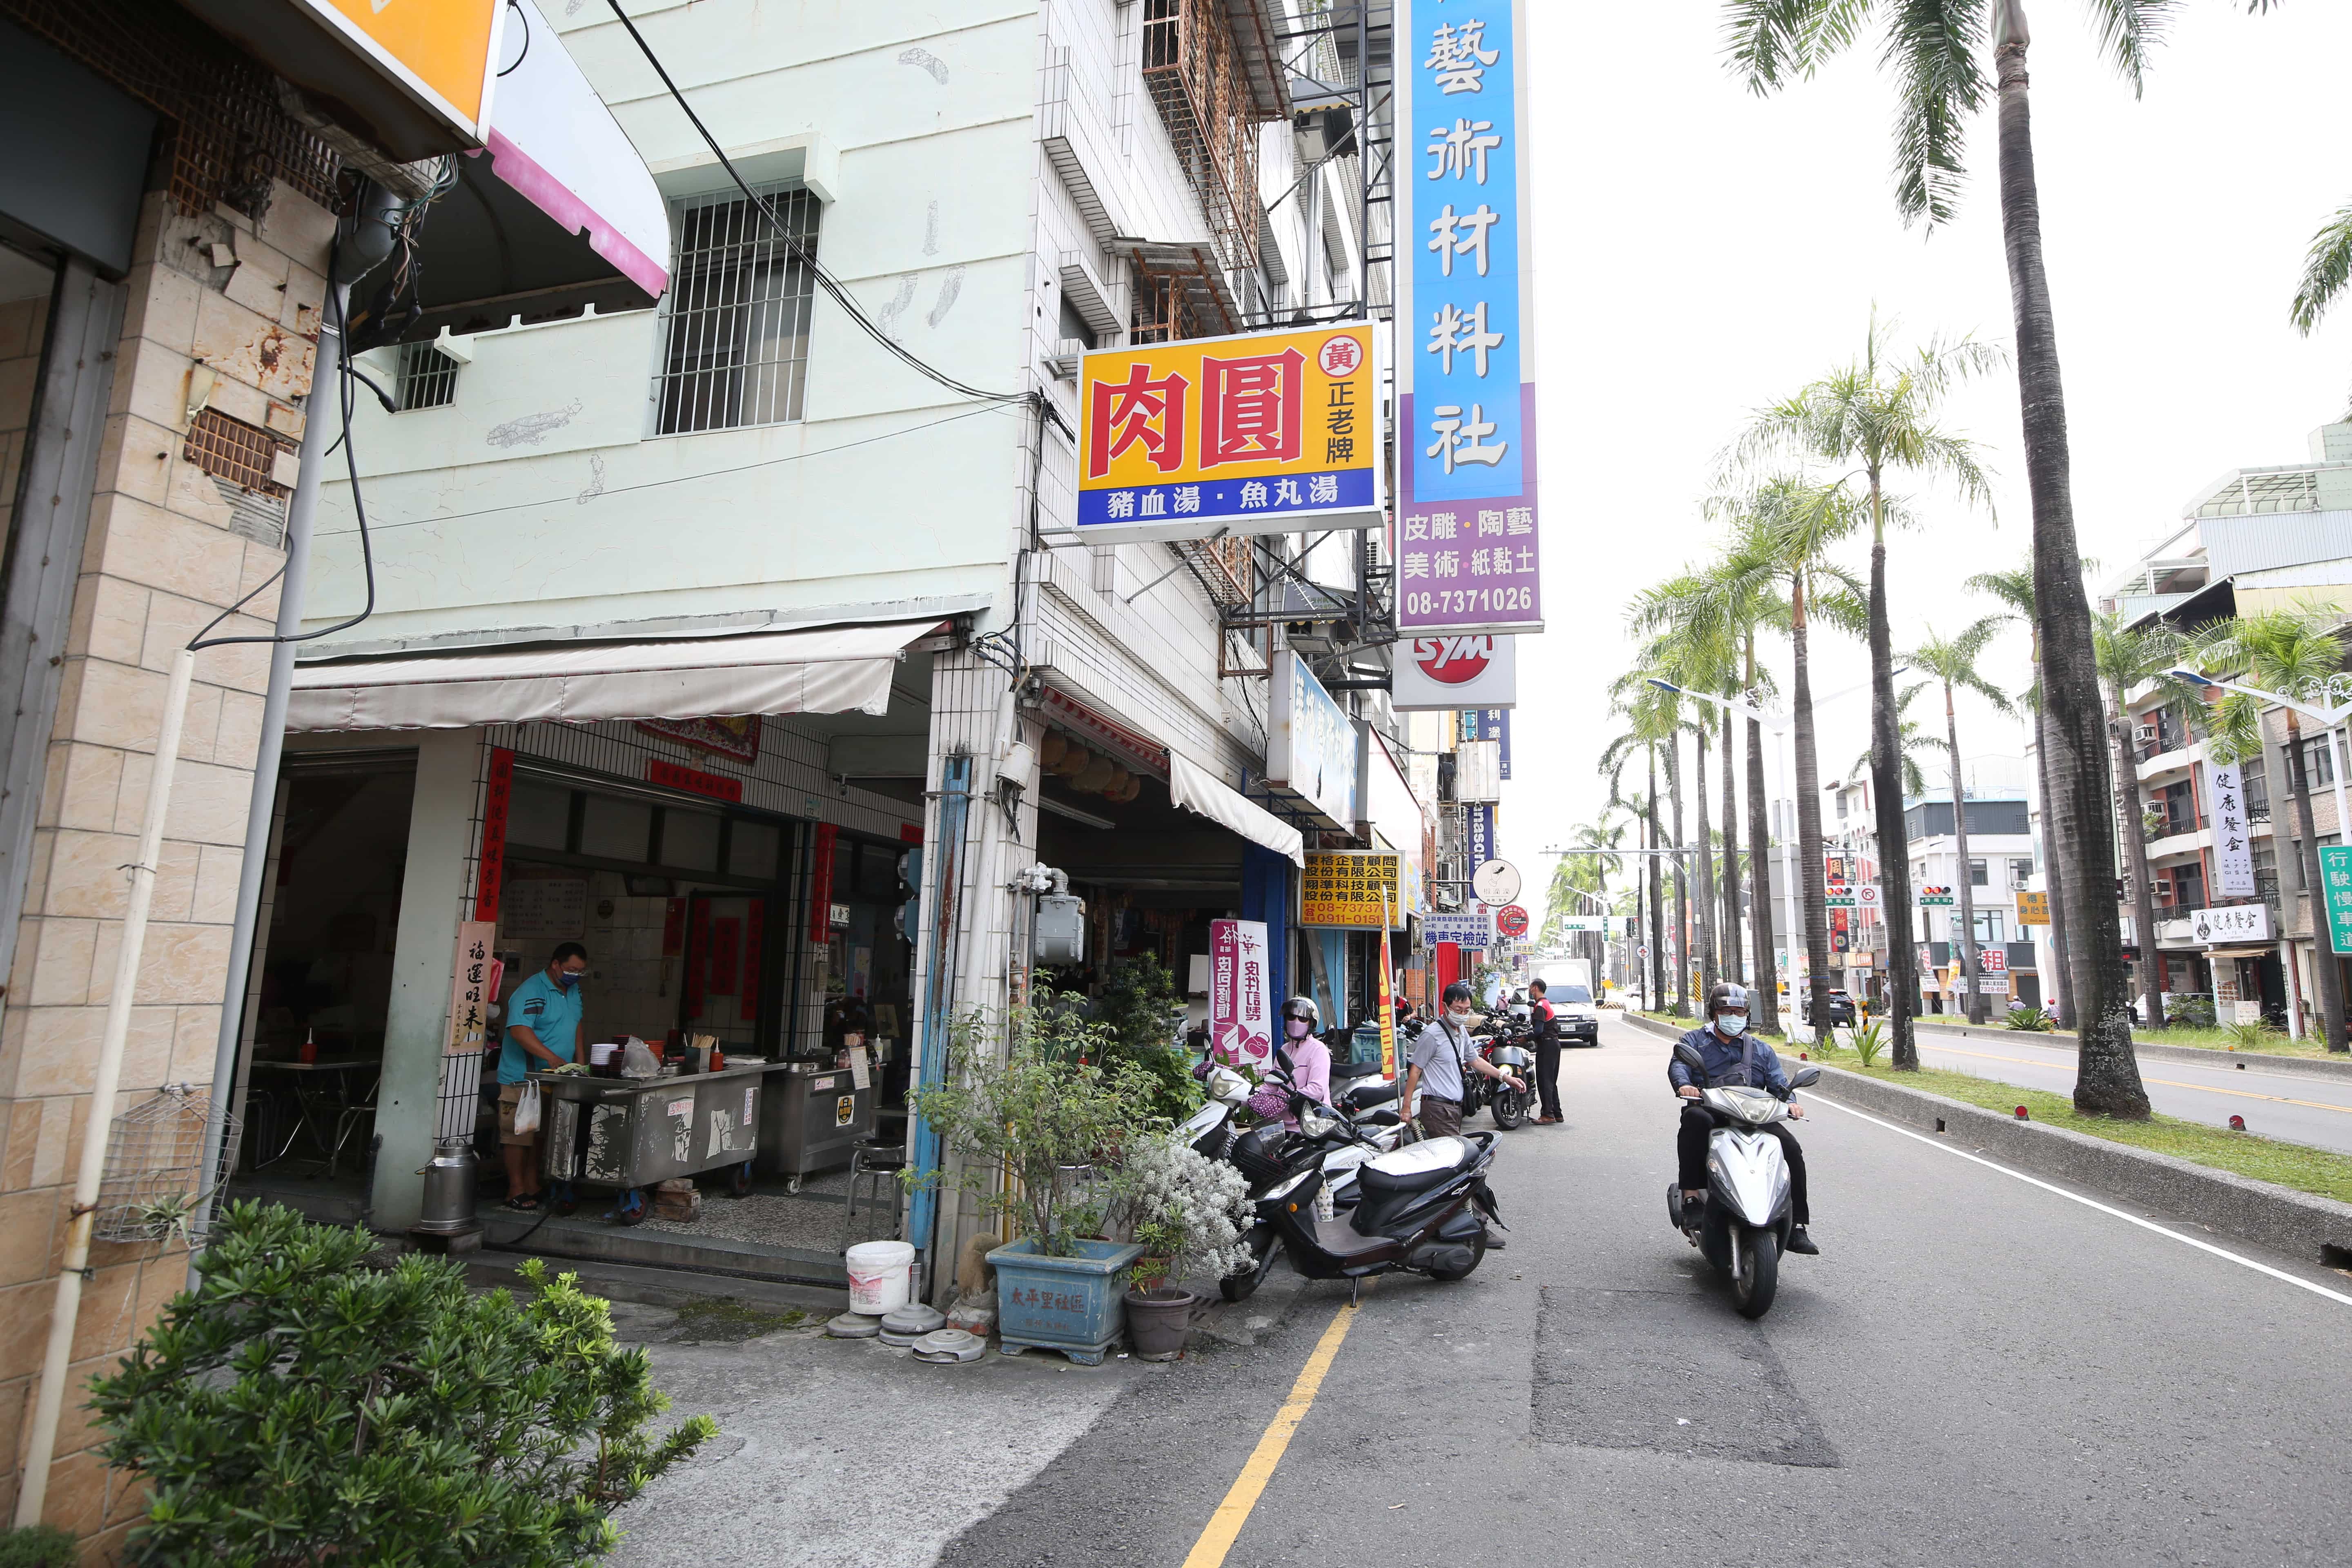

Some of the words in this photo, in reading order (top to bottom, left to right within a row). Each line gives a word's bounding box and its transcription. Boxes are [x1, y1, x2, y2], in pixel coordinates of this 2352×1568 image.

[1424, 18, 1508, 475] 藝術材料社
[1326, 343, 1355, 370] 黃
[1089, 346, 1307, 479] 肉圓
[1326, 381, 1354, 464] 正老牌
[1407, 586, 1531, 615] 08-7371026
[1414, 635, 1493, 669] SYM
[1305, 856, 1397, 866] 東格企管顧問
[1305, 867, 1396, 878] 股份有限公司
[1304, 891, 1396, 902] 股份有限公司
[2328, 852, 2352, 947] 行駛慢車道
[1318, 914, 1396, 924] 0911-01517
[1425, 931, 1488, 946] 機車定檢站
[1982, 950, 2006, 971] 租
[463, 940, 485, 1029] 福運旺來
[1010, 1287, 1085, 1313] 太平里社區
